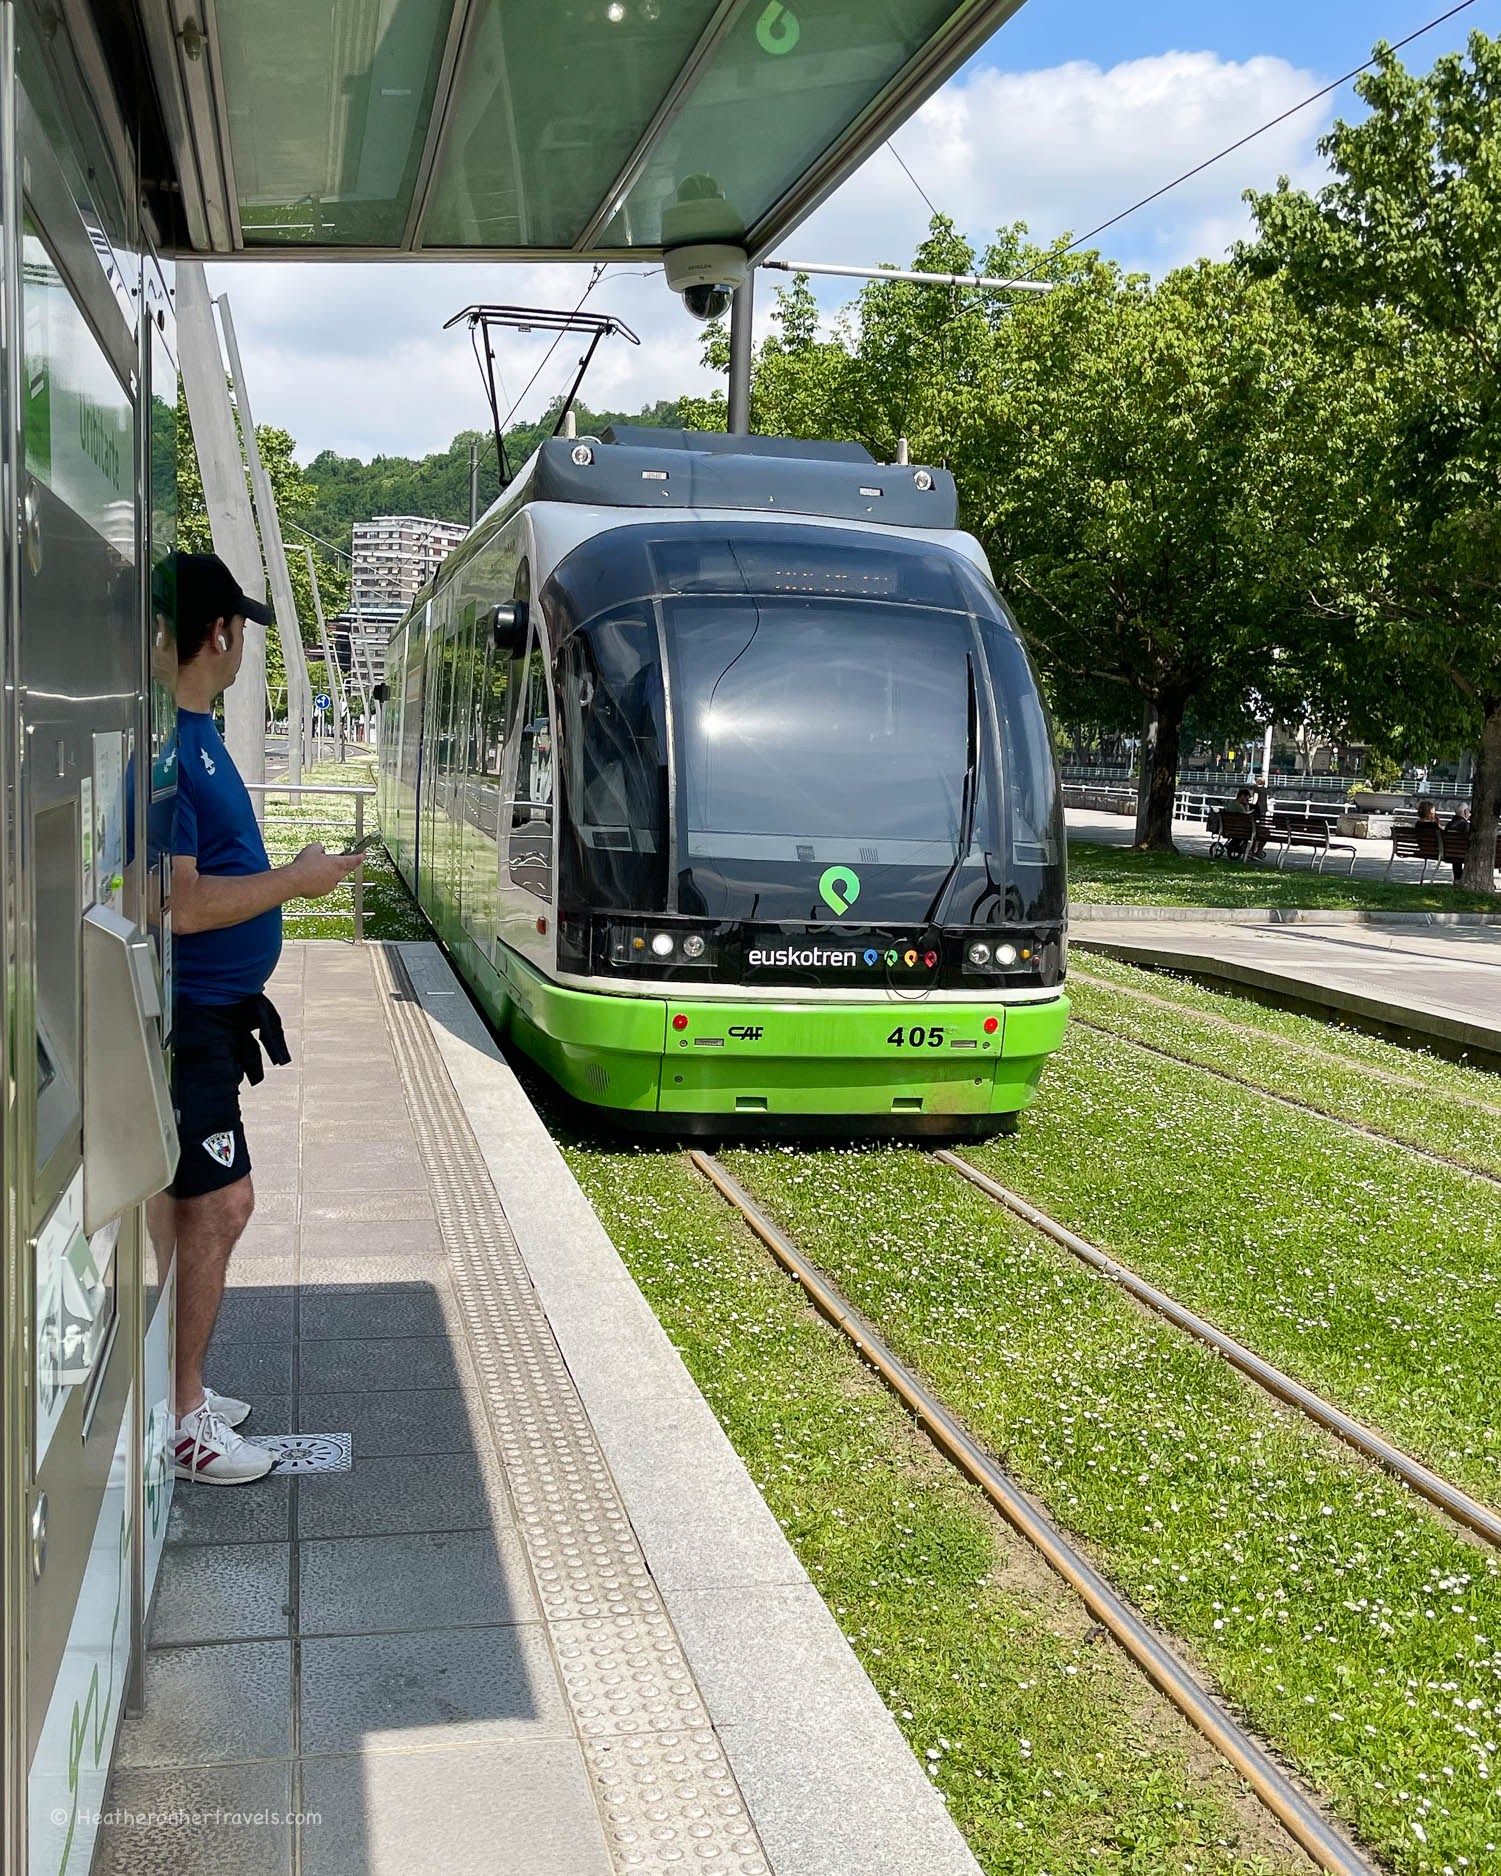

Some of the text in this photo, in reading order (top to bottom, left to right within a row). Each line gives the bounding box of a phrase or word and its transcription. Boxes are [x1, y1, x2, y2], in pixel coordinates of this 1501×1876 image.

[748, 946, 857, 967] euskotren
[728, 1026, 764, 1041] CAF
[887, 1026, 945, 1048] 405
